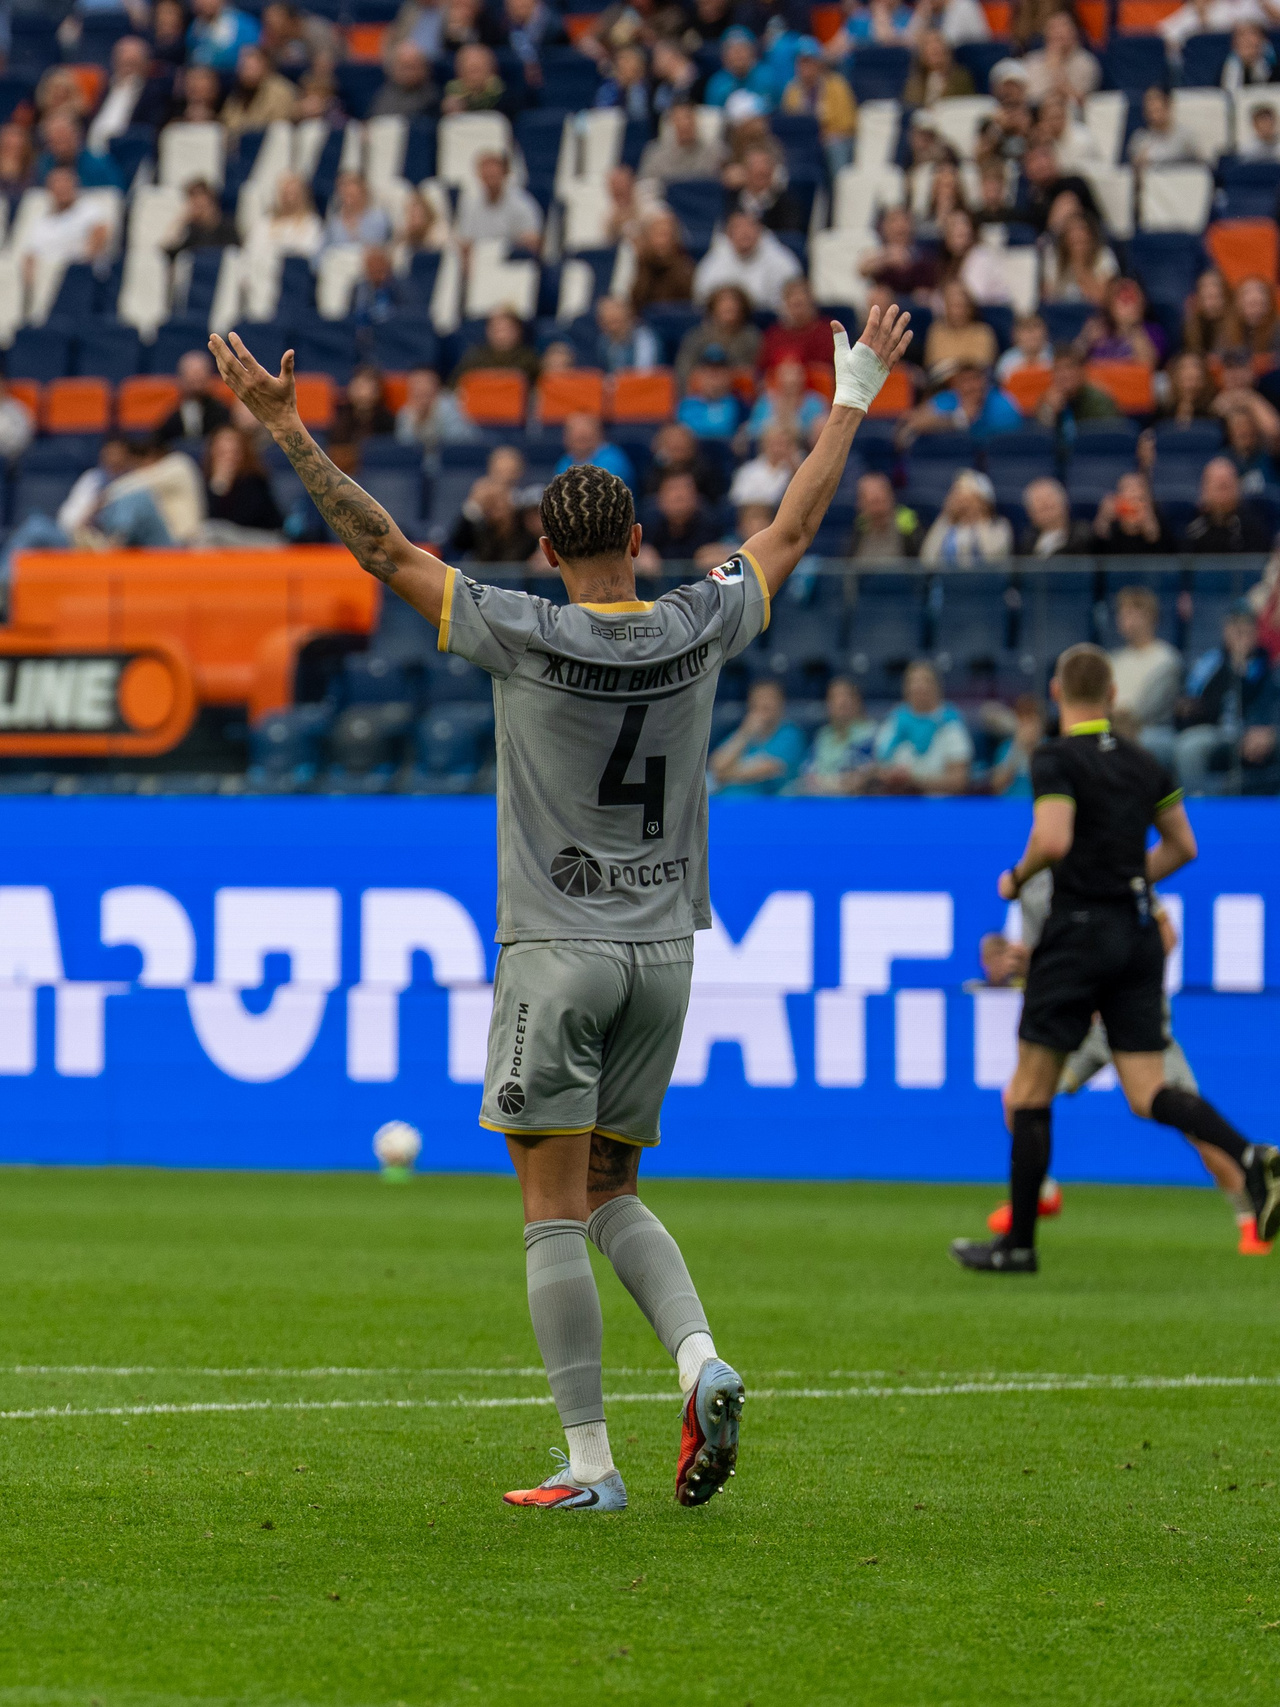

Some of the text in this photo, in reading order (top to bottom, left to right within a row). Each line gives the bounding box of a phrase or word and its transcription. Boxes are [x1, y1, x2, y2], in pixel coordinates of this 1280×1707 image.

[539, 642, 709, 692] ЖОАО ВИКТОР
[598, 704, 666, 840] 4
[510, 1002, 529, 1078] РОССЕТИ
